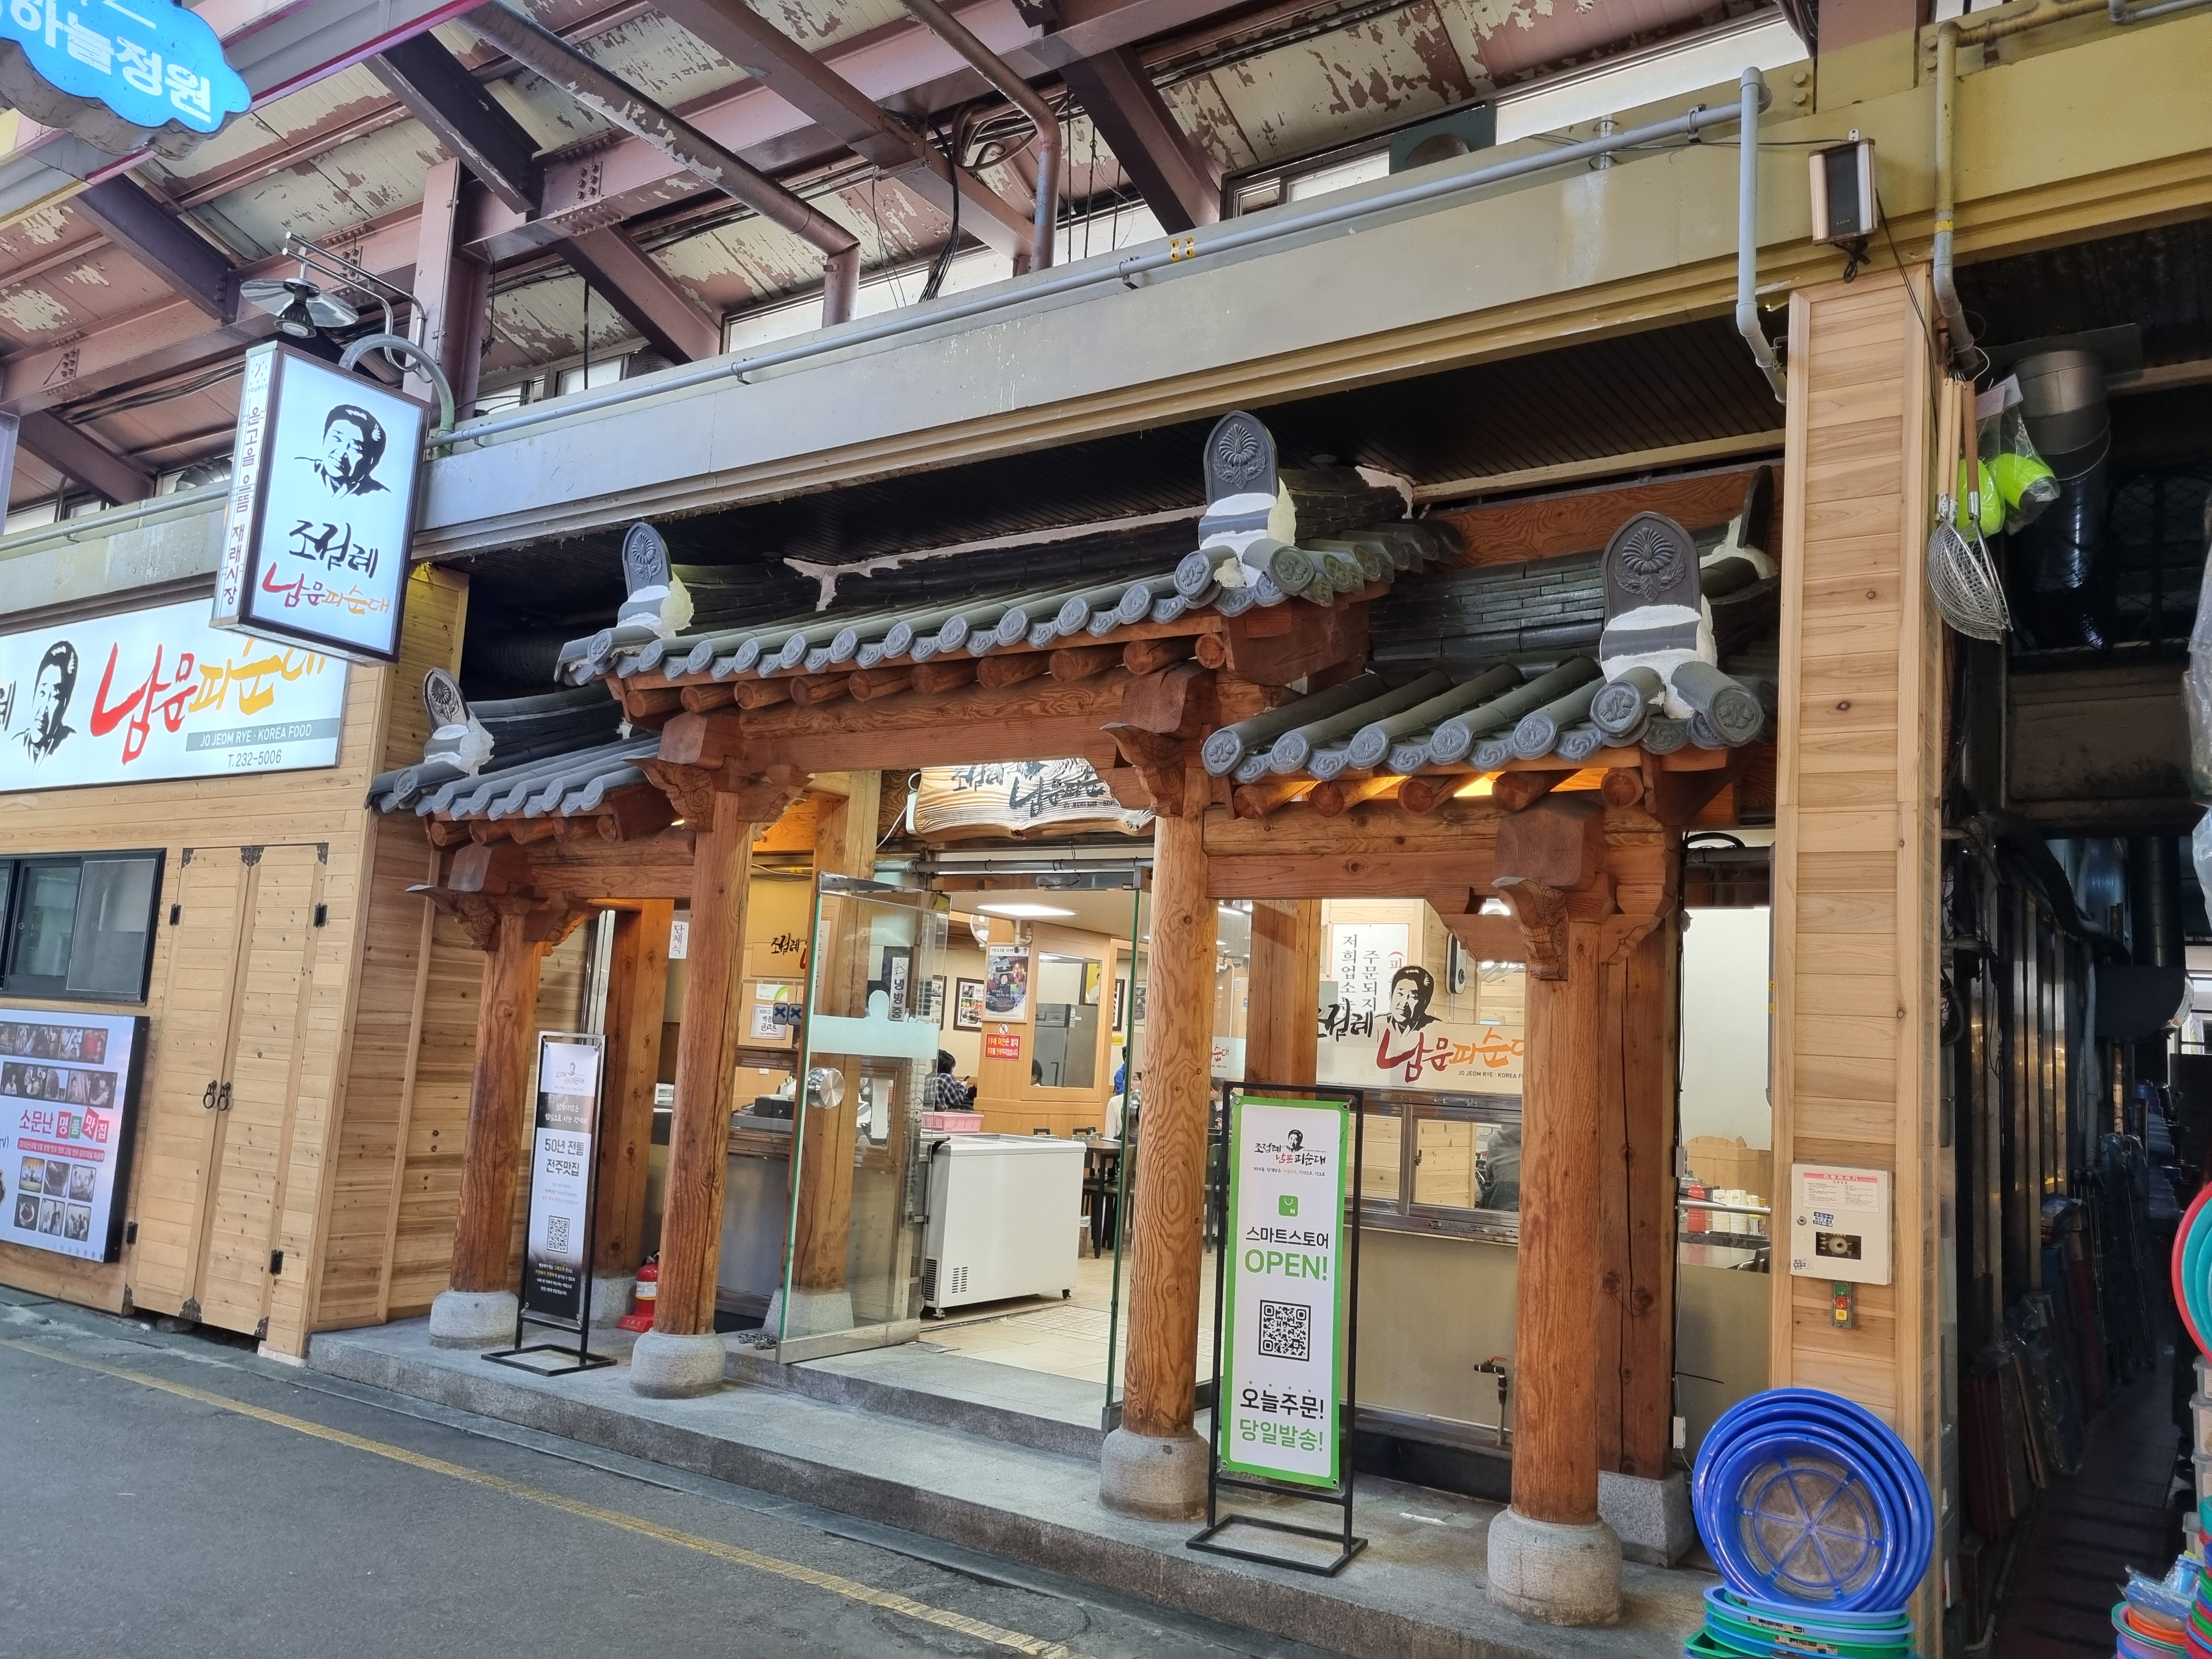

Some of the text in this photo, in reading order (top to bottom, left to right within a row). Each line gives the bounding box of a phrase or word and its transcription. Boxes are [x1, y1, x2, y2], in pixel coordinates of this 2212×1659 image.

[224, 407, 261, 605] 온고을 으뜸 재래시장
[289, 520, 379, 579] 조점례
[200, 724, 312, 747] JO JEOM RYE KOREA FOOD
[1009, 766, 1105, 819] 남문피순
[672, 924, 685, 955] 단체석
[891, 979, 905, 1019] 냉방중
[19, 1109, 107, 1140] 소문난 명품 맛집
[545, 1138, 585, 1156] 50년 전통
[1254, 1143, 1282, 1153] 조점례
[546, 1158, 580, 1177] 전주맛집
[1246, 1226, 1329, 1249] 스마트스토어
[1245, 1249, 1328, 1282] OPEN!
[1240, 1388, 1324, 1420] 오늘주문!
[1240, 1419, 1323, 1452] 당일발송!
